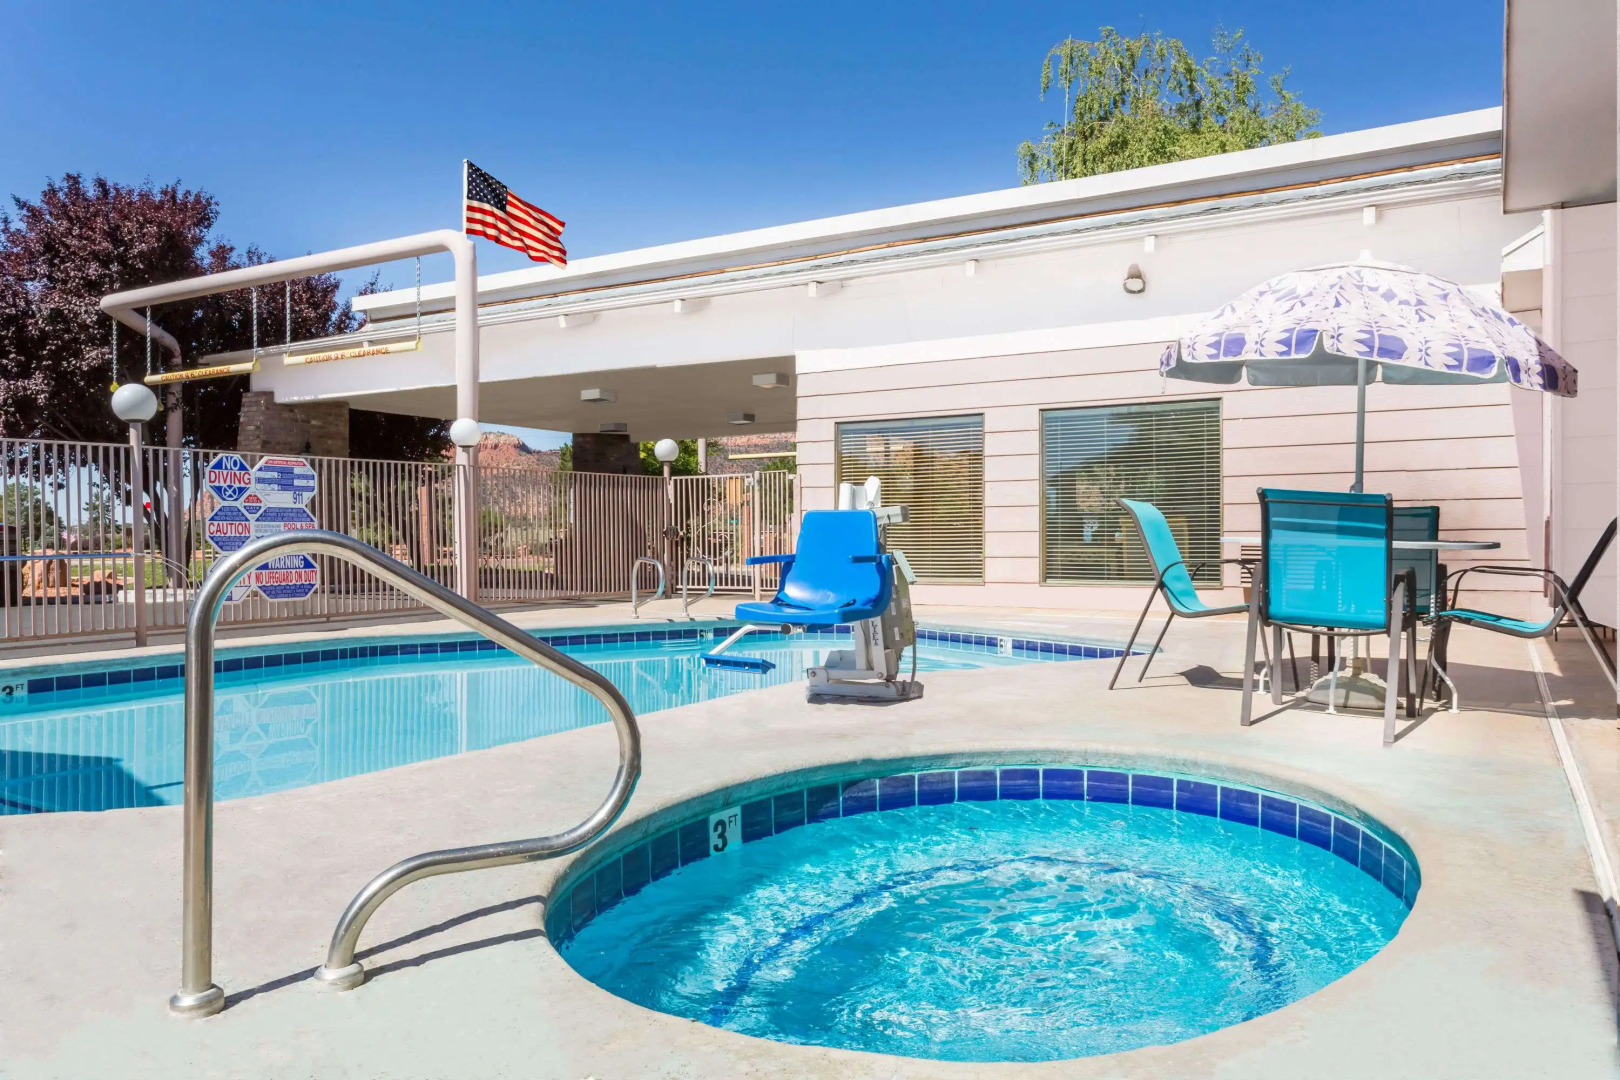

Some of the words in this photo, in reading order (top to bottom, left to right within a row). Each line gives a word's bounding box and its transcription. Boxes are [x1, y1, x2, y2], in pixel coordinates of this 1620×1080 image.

[305, 354, 332, 364] CAUTION
[350, 346, 391, 358] CLEARANCE
[161, 373, 184, 382] CAUTION
[197, 366, 231, 377] CLEARANCE
[222, 456, 240, 470] NO
[208, 470, 251, 485] DIVING
[292, 491, 304, 504] 911
[208, 522, 251, 535] CAUTION
[283, 522, 299, 530] POOL
[304, 522, 315, 530] SPA
[268, 555, 304, 569] WARNING
[255, 571, 264, 584] NO
[264, 570, 294, 584] LIFEGUARD
[294, 570, 303, 583] ON
[304, 569, 318, 583] DUTY
[15, 683, 24, 691] FT
[713, 819, 728, 852] 3
[728, 813, 738, 828] FT
